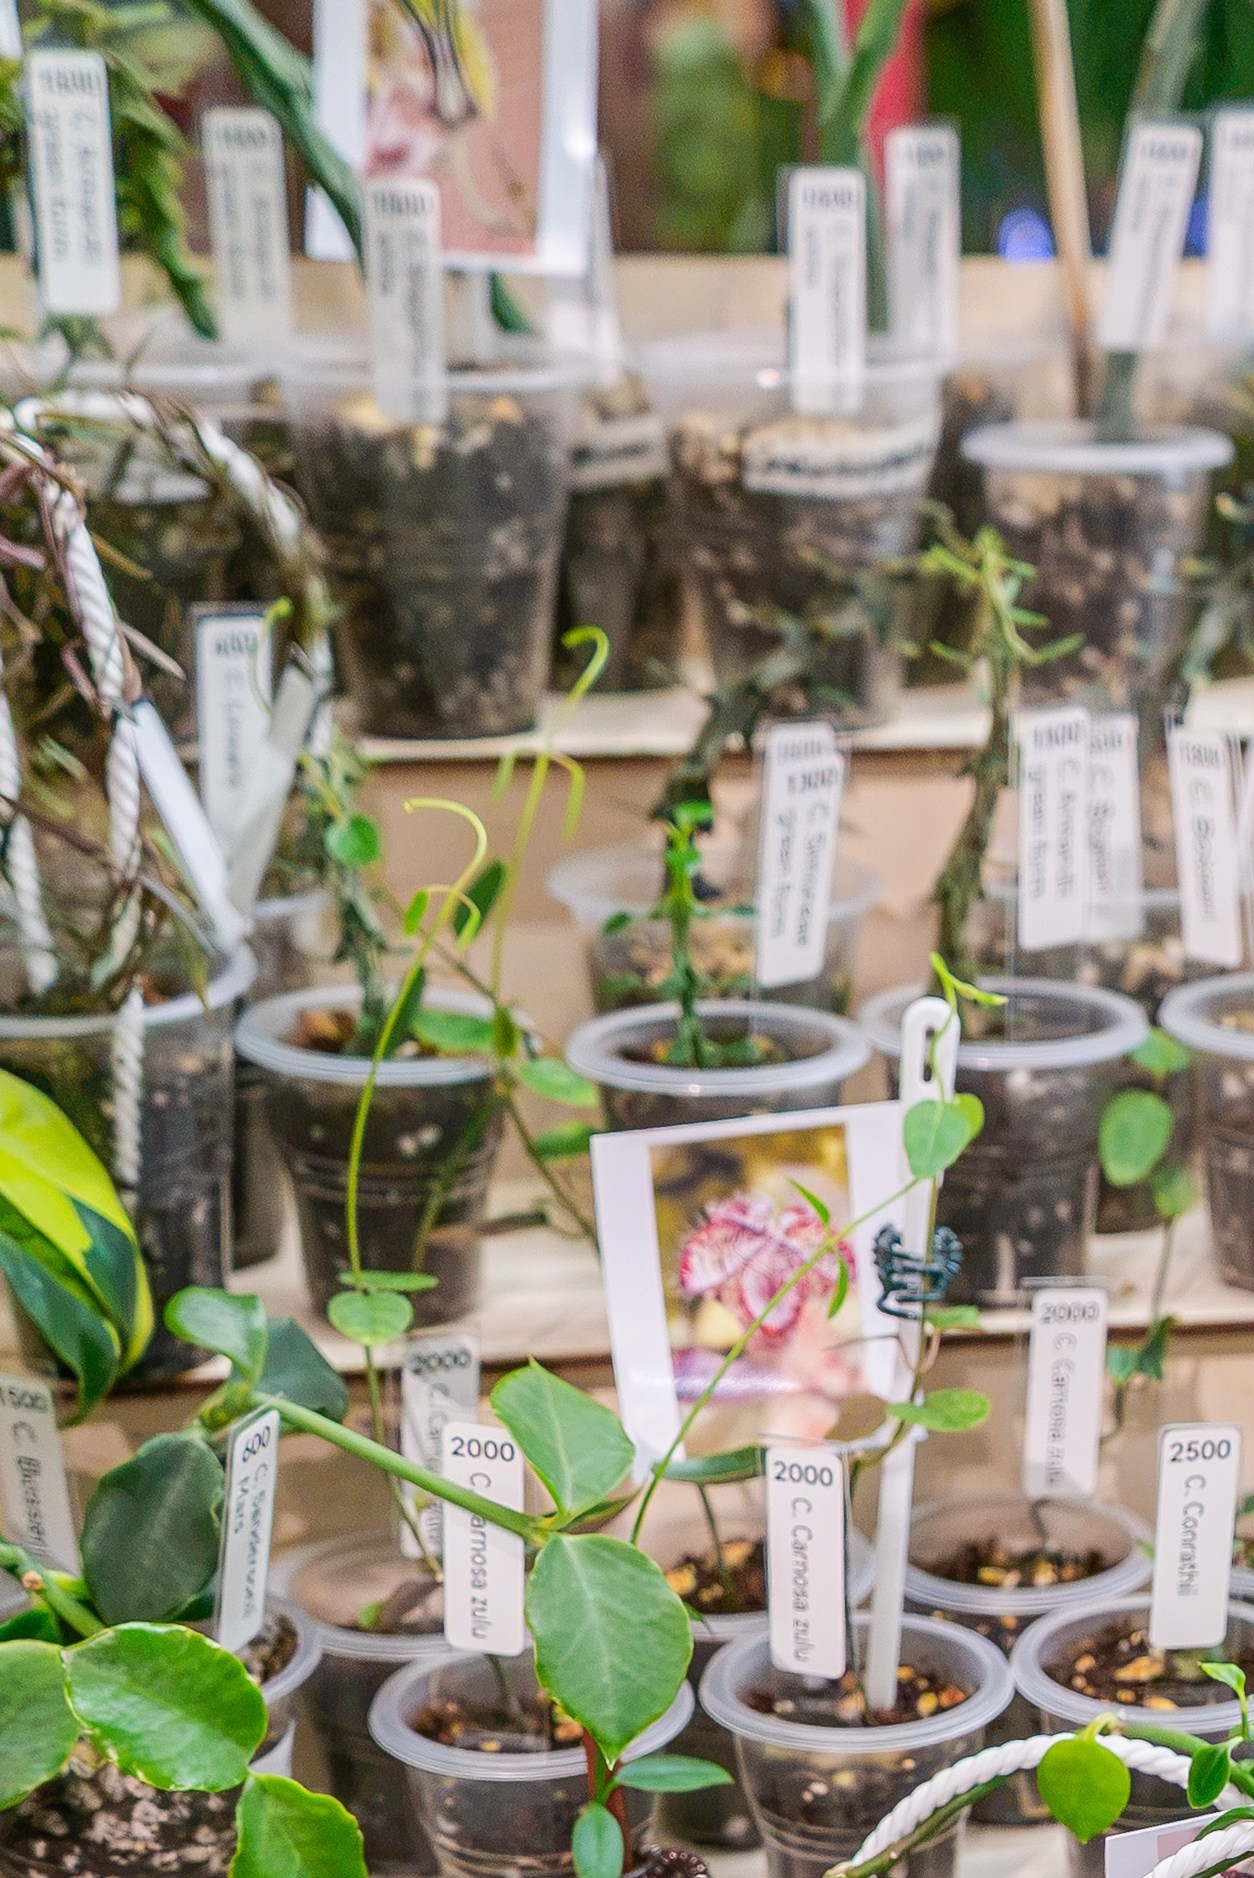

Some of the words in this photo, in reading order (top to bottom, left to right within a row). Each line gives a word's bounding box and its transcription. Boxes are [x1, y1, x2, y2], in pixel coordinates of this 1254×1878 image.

[451, 1436, 515, 1462] 2000
[1169, 1439, 1232, 1463] 2500
[773, 1460, 834, 1487] 2000
[1183, 1474, 1207, 1498] C.
[791, 1497, 812, 1518] C.
[1177, 1500, 1205, 1597] Conrathii
[791, 1524, 813, 1613] Carnosa
[471, 1596, 493, 1640] zulu
[793, 1618, 815, 1663] zulu
